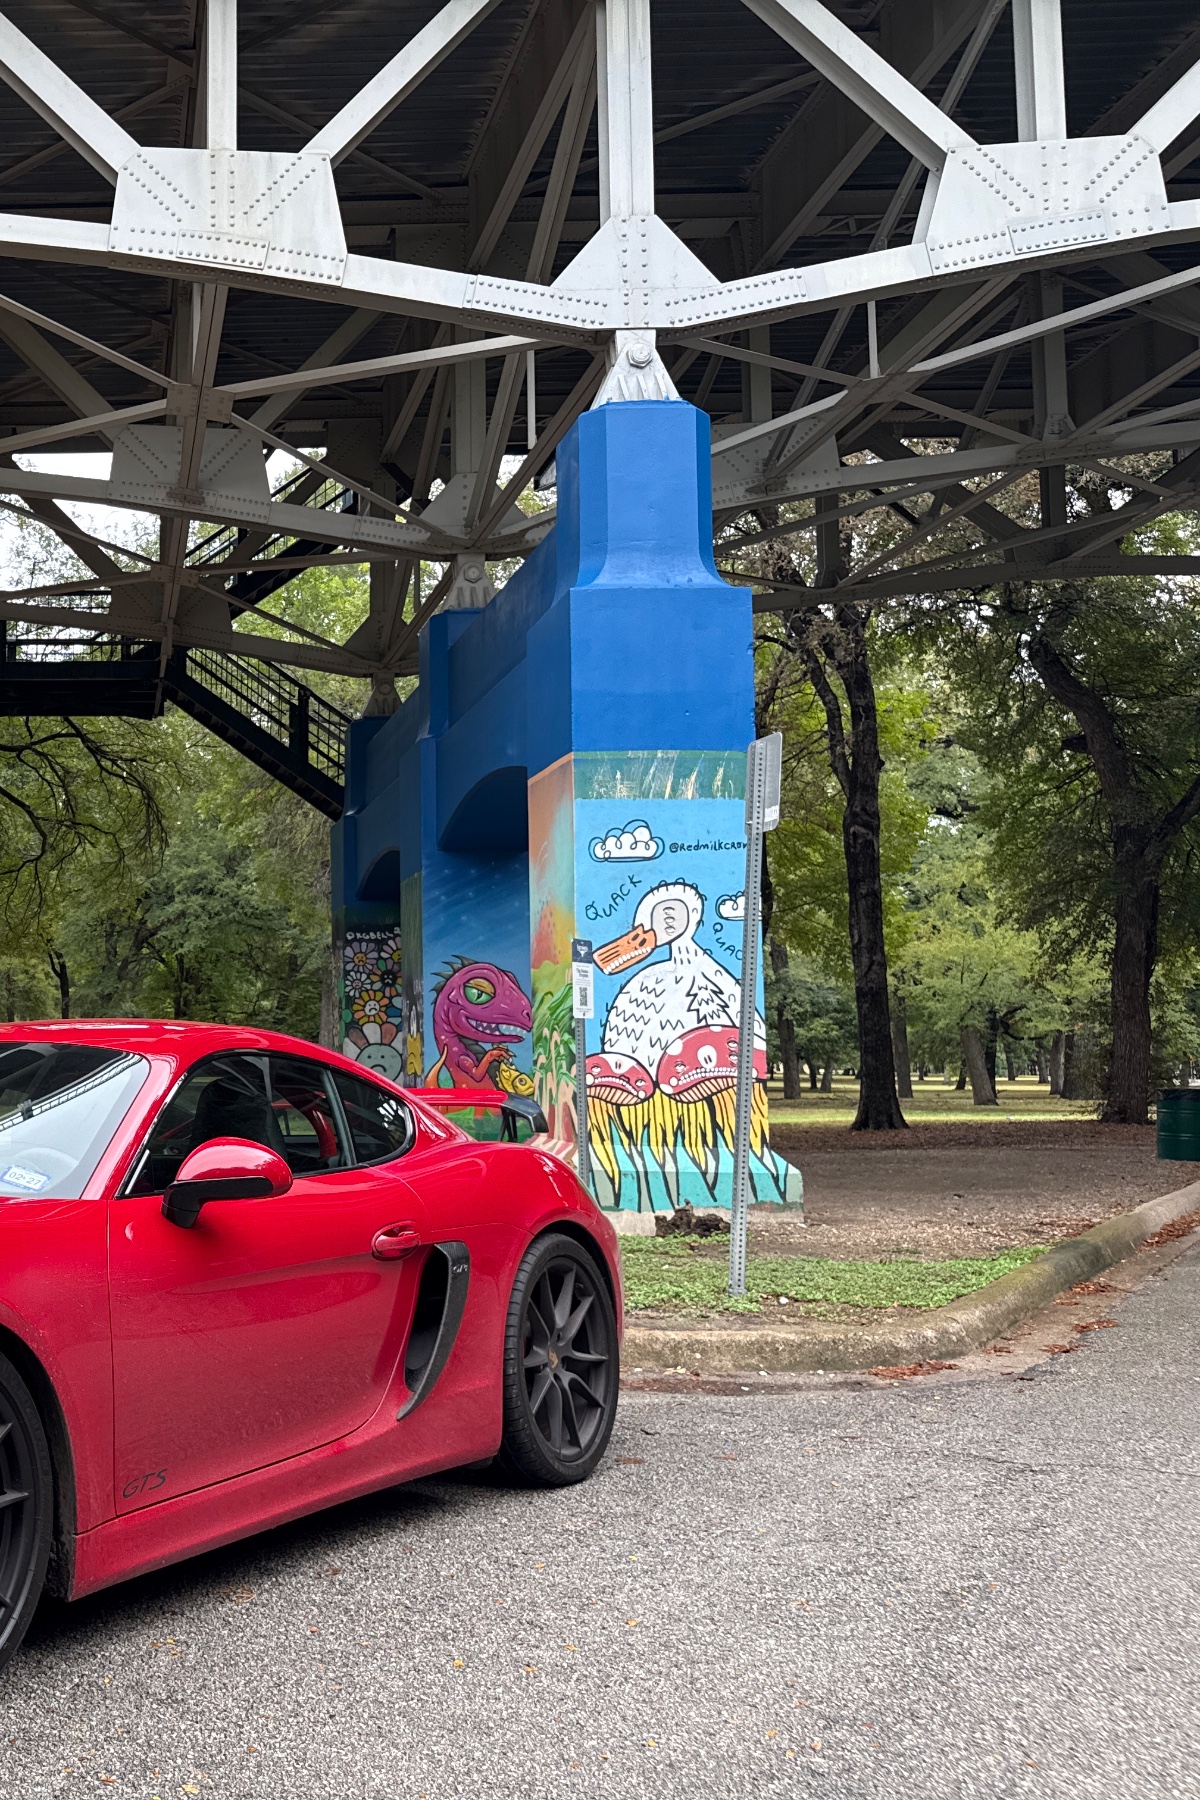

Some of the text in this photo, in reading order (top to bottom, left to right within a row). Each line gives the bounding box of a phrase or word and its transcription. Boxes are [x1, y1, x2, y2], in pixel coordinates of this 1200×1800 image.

[585, 874, 642, 921] QUACK
[712, 922, 743, 961] QUAC
[122, 1468, 168, 1499] GTS
